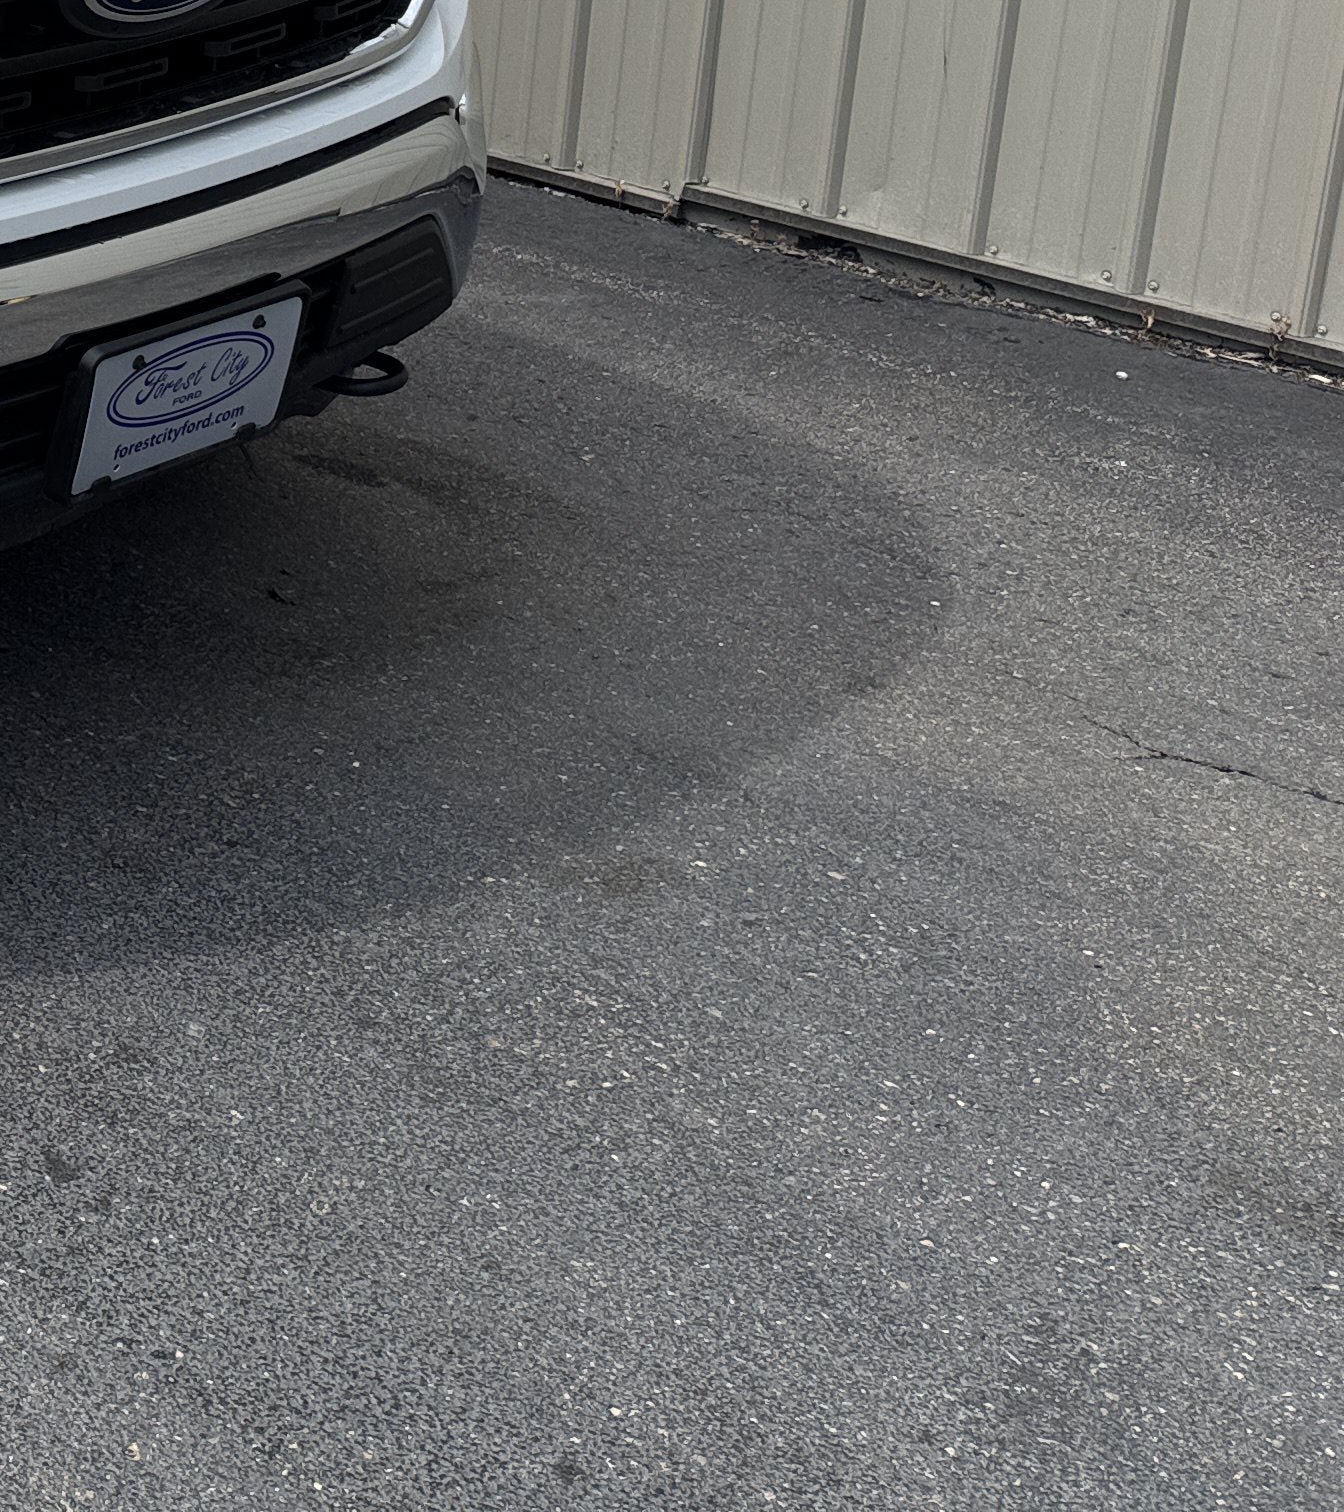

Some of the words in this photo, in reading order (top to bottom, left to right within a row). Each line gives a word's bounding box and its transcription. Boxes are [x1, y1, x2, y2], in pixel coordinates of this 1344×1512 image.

[135, 360, 207, 406] Forest
[210, 347, 249, 386] City
[172, 390, 203, 407] FORD
[114, 404, 245, 461] forestcityford.com
